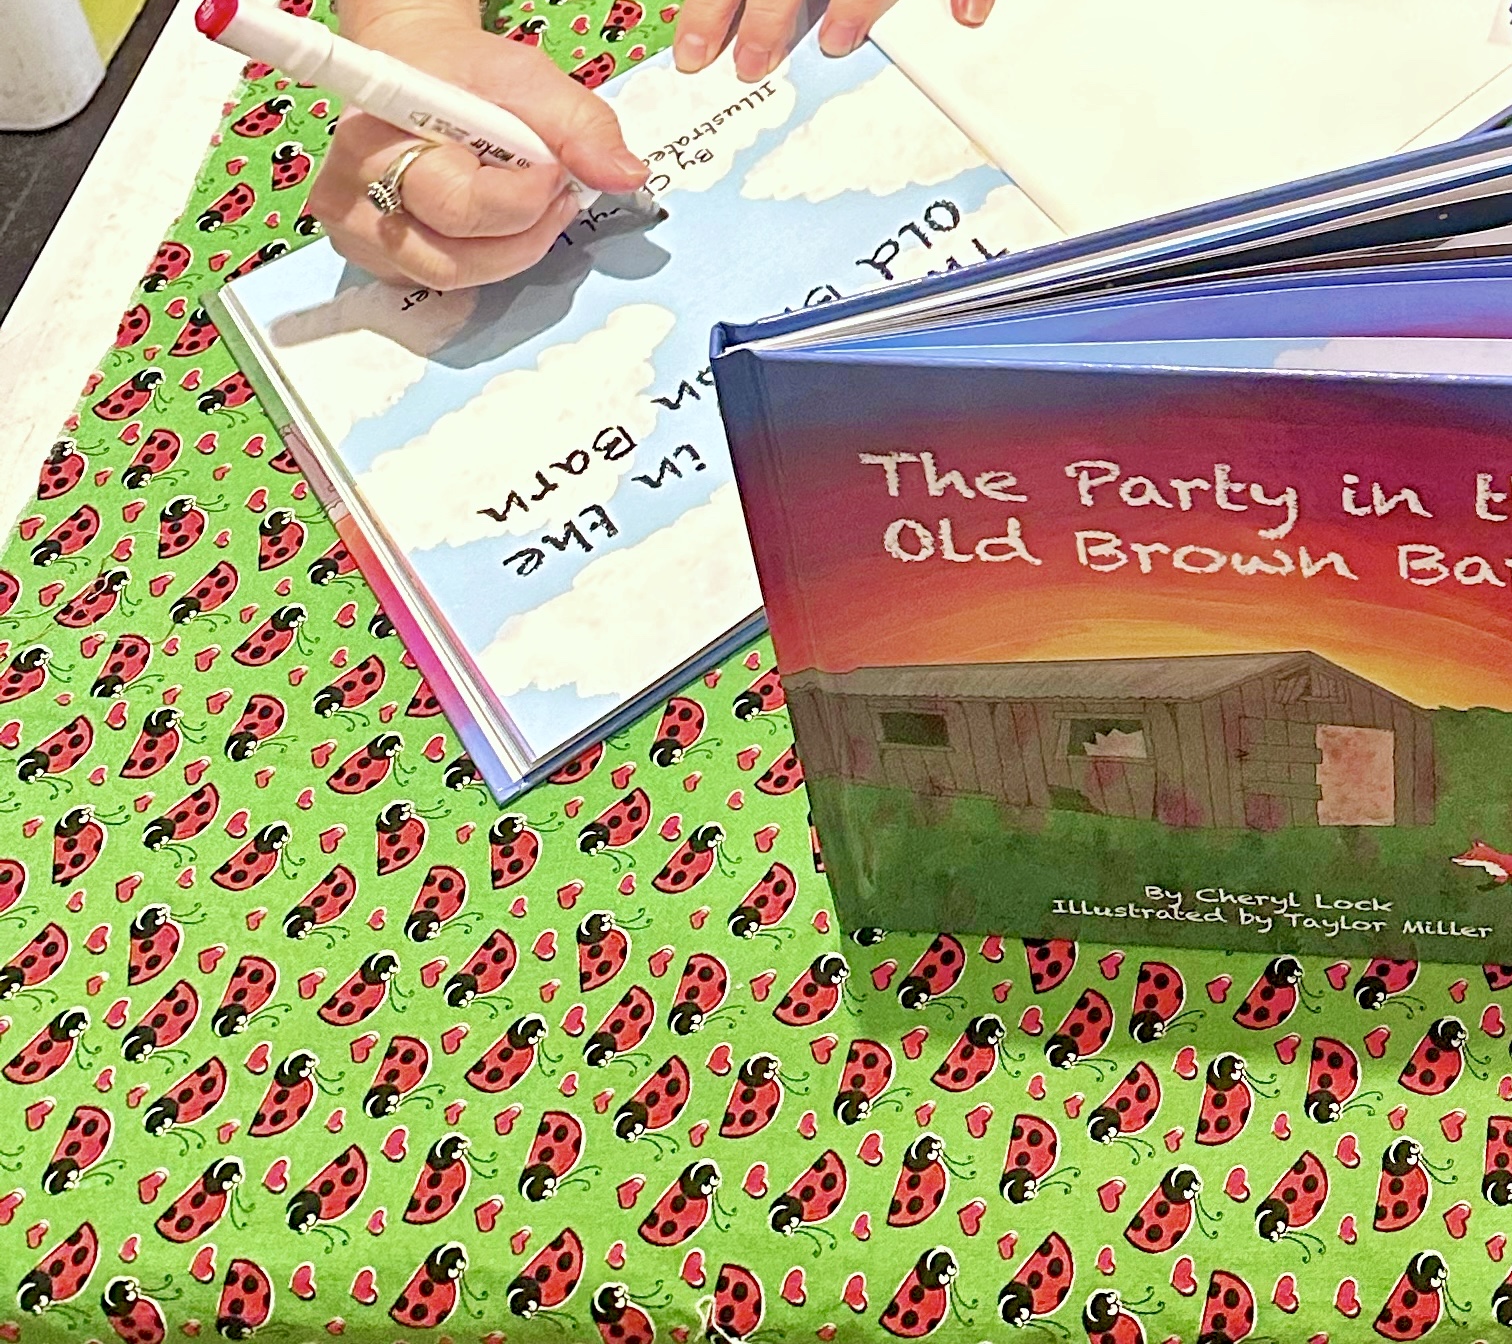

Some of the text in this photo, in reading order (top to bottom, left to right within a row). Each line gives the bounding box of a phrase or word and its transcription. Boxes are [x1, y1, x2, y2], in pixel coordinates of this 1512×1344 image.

[676, 148, 714, 170] By
[855, 199, 961, 281] Old
[476, 424, 638, 522] Barn
[858, 450, 1027, 502] The
[1064, 458, 1299, 540] Party
[1341, 474, 1433, 518] in
[502, 443, 707, 577] in the
[883, 517, 1042, 566] Old
[1075, 528, 1358, 581] Brown
[1052, 898, 1493, 940] Illustrated by Taylor Miller
[1144, 885, 1393, 913] By Cheryl Lock
